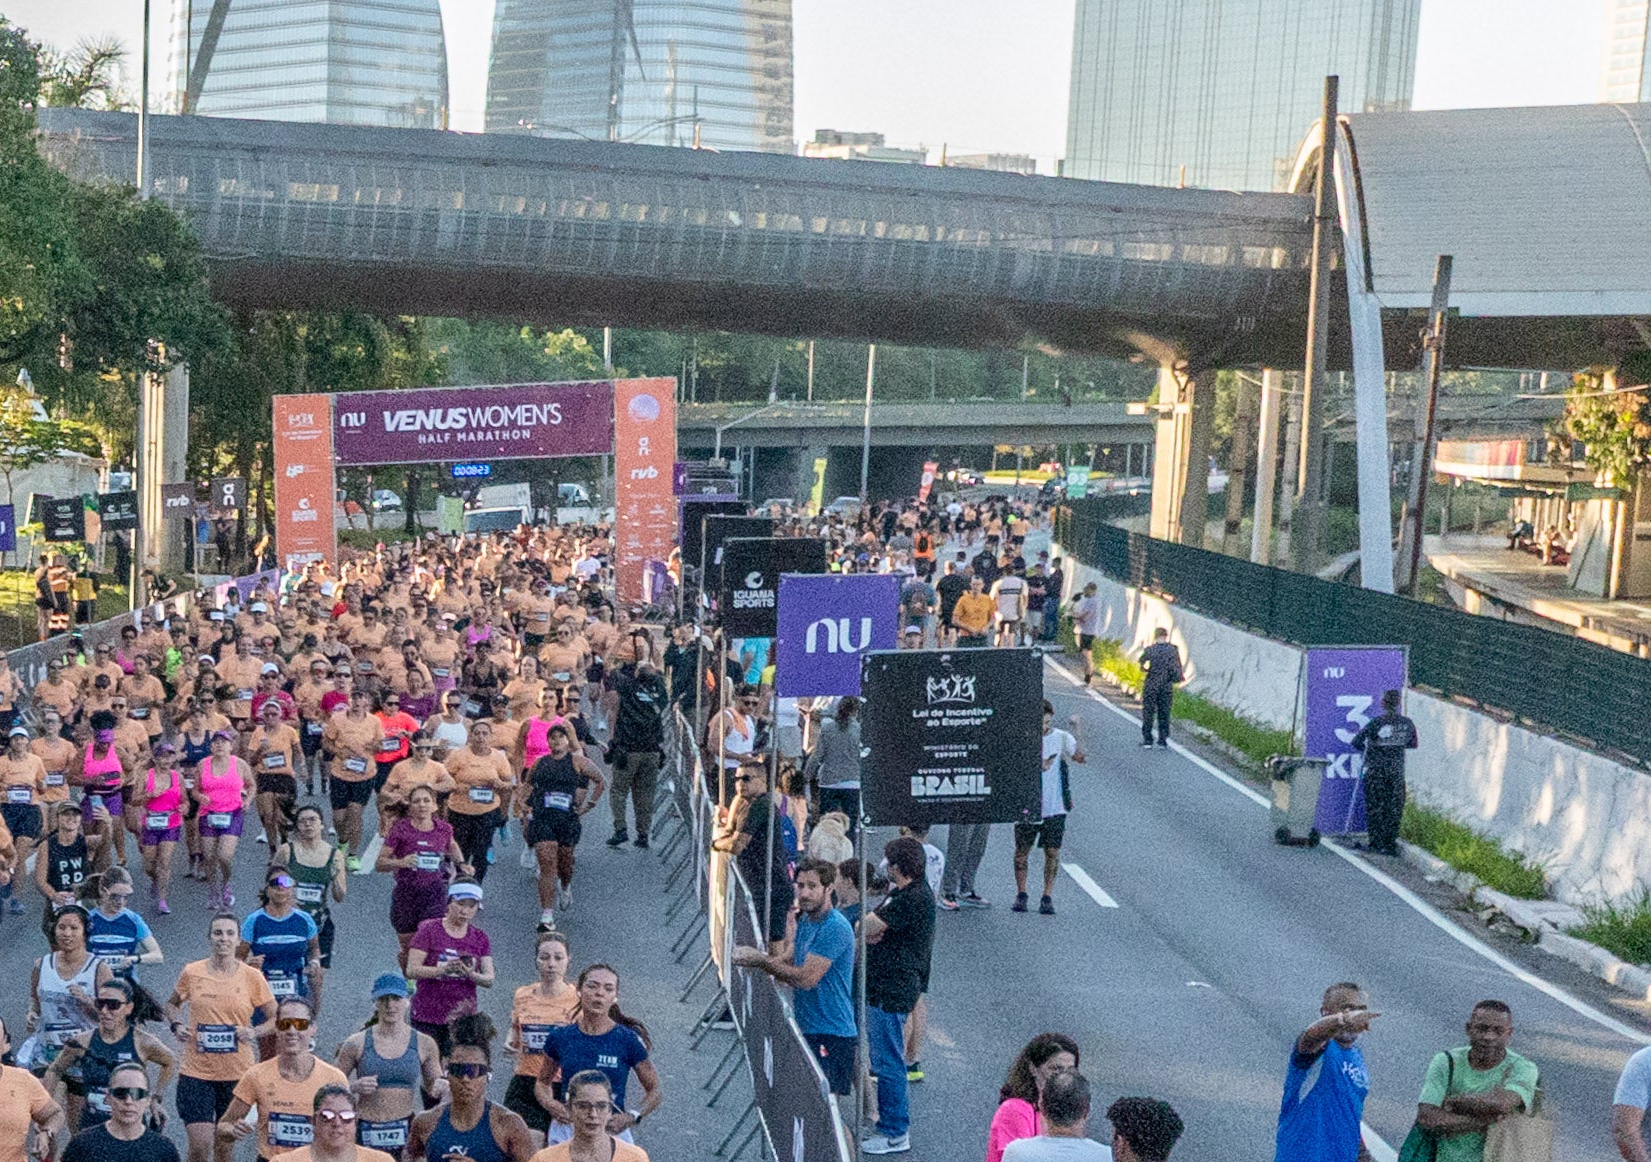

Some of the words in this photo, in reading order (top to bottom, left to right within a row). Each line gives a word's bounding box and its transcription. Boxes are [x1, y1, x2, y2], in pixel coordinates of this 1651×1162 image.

[340, 411, 366, 428] nu
[417, 433, 451, 445] HALF
[456, 429, 531, 442] MARATHON
[630, 466, 659, 480] rvb
[733, 590, 775, 600] IGUANA
[733, 598, 775, 608] SPORTS
[805, 617, 872, 654] nu
[1323, 666, 1345, 679] nu
[912, 709, 929, 718] Lei
[931, 709, 944, 718] de
[946, 708, 994, 718] Incentivo
[1334, 695, 1373, 744] 3
[926, 719, 940, 727] ao
[910, 774, 992, 797] BRASIL
[282, 1126, 311, 1136] 2539
[376, 1131, 400, 1142] 1747
